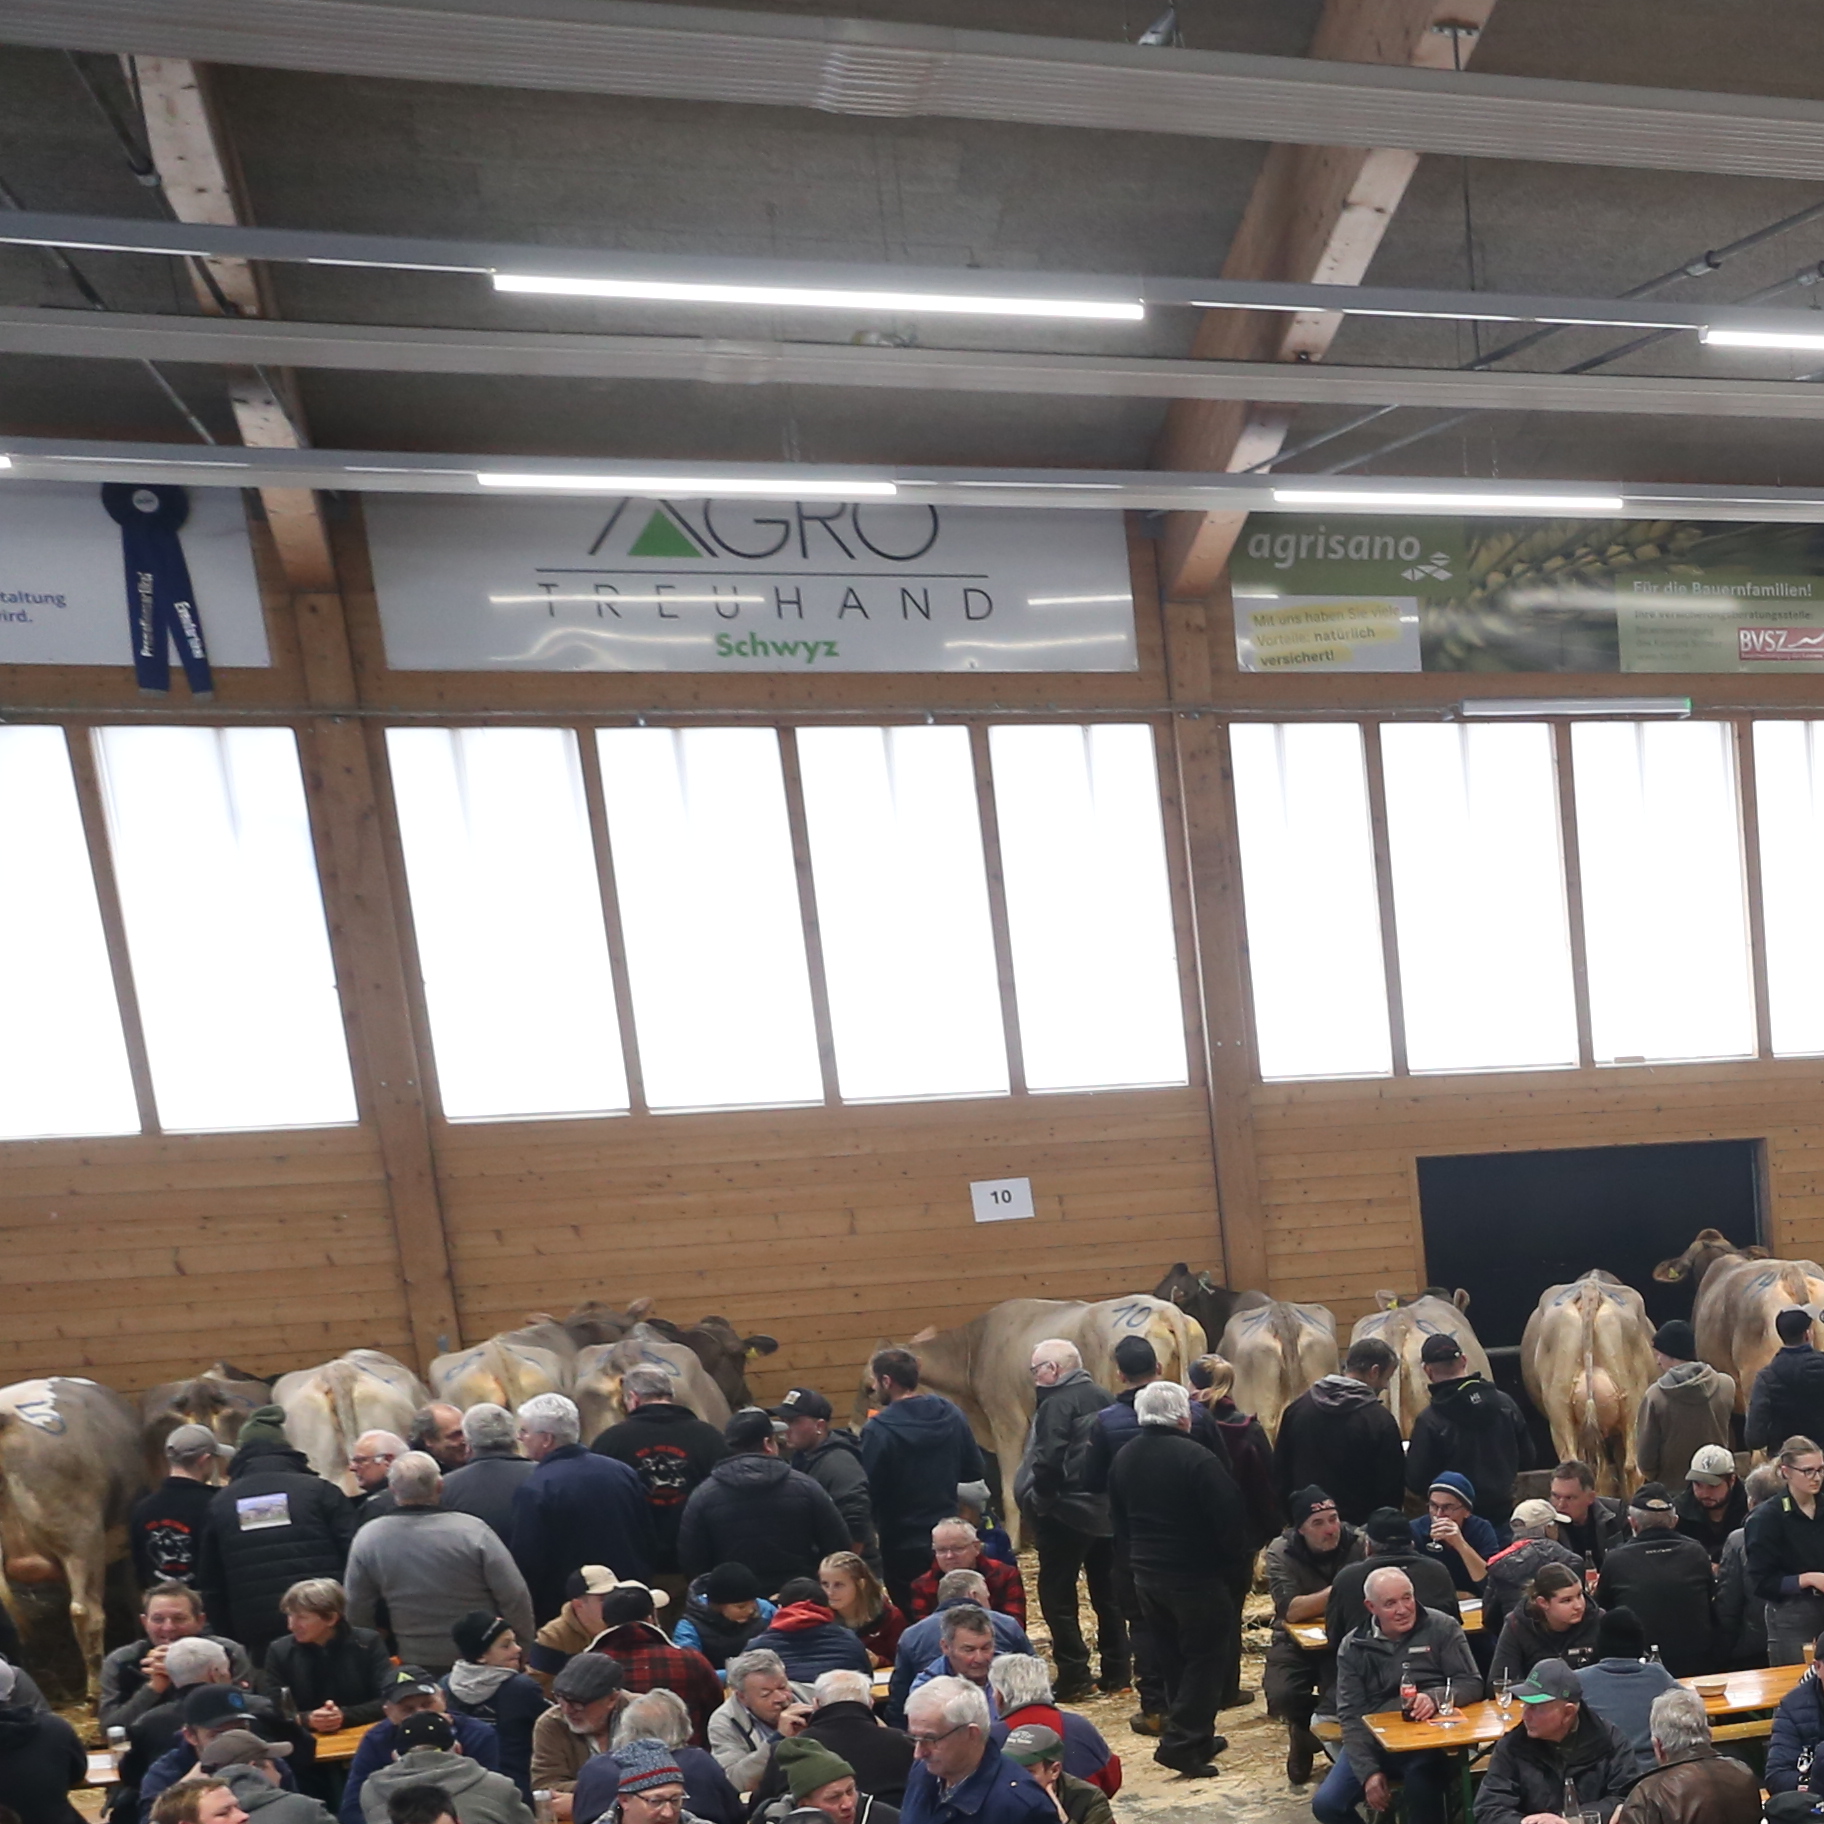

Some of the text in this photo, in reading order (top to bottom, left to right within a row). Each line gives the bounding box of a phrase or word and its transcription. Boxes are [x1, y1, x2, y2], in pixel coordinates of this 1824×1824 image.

[1247, 525, 1422, 570] agrisano
[1633, 581, 1813, 598] Für die Bauernfamilien!
[536, 582, 994, 623] TREUHAND
[1253, 604, 1400, 627] Mit uns haben Sie viele
[715, 632, 840, 663] Schwyz
[1257, 626, 1377, 647] Vorteile: natürlich
[1739, 630, 1789, 652] BVSZ
[1260, 650, 1335, 667] versichert!
[990, 1189, 1013, 1205] 10
[1111, 1302, 1153, 1329] 10
